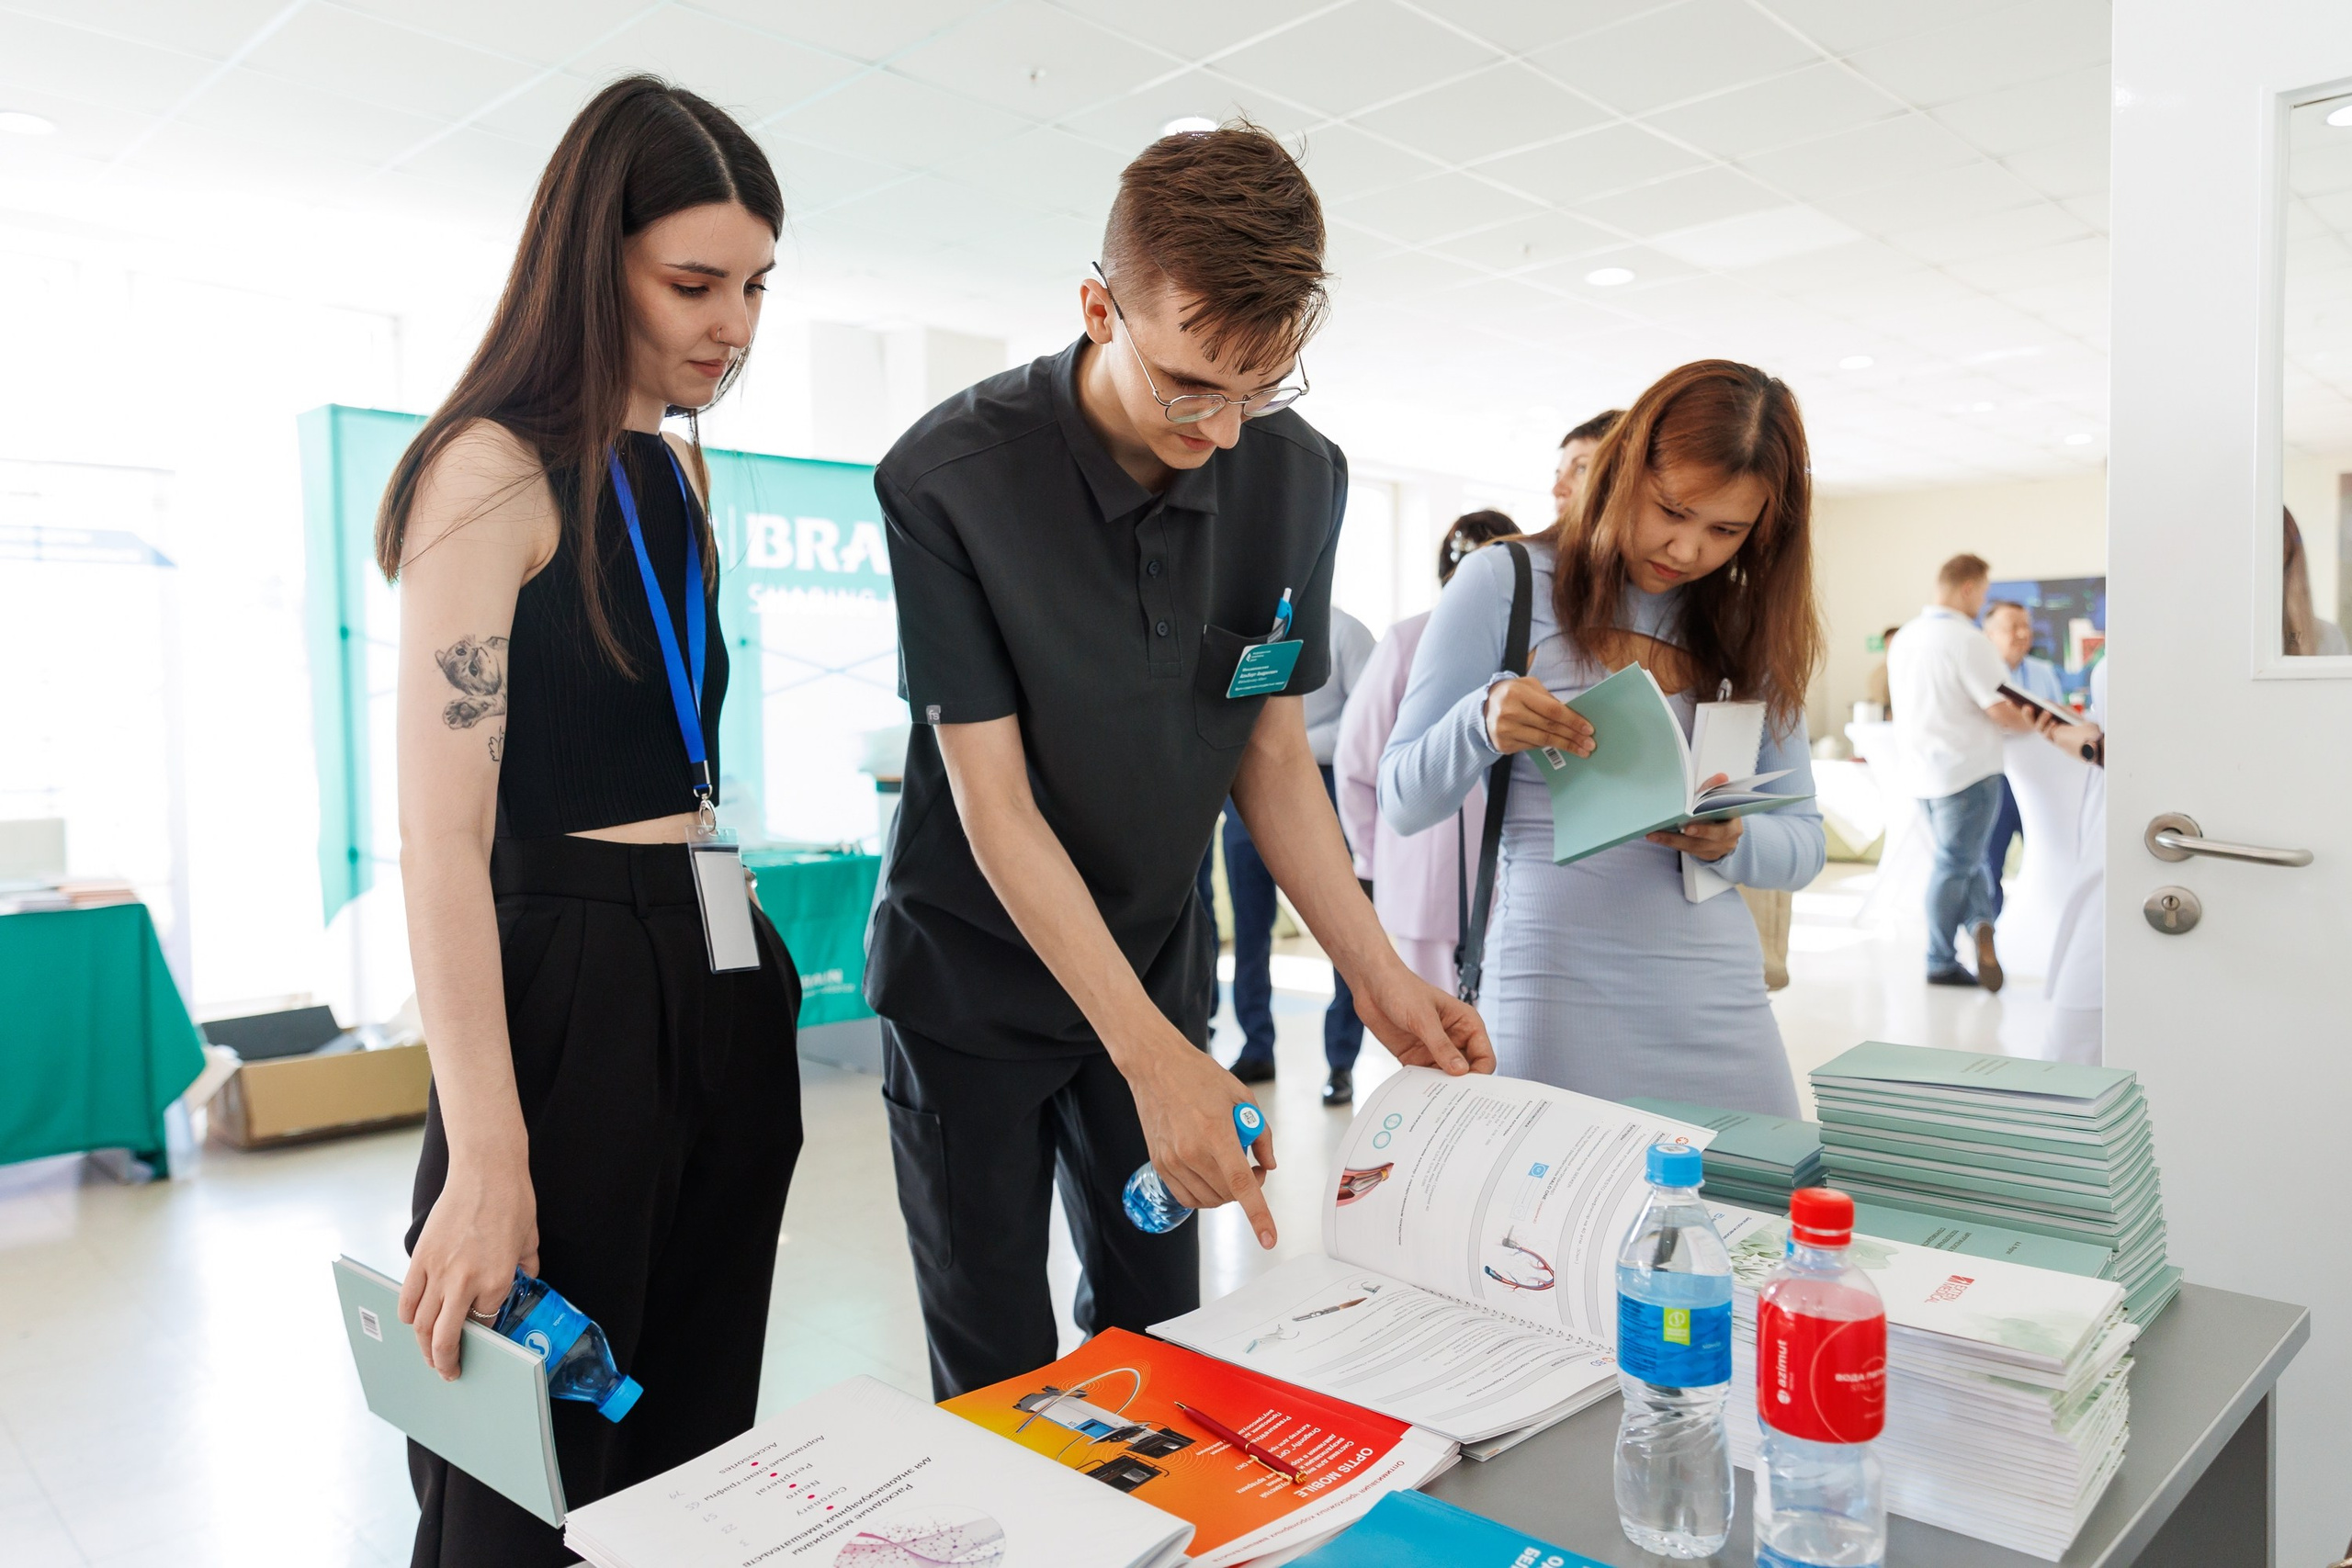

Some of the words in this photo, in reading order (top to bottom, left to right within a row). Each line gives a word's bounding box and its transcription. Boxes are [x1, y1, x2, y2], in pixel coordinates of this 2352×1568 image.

[745, 512, 890, 575] BRA
[1540, 1189, 1550, 1201] ONE
[1545, 1176, 1557, 1190] HALO
[1776, 1339, 1788, 1388] azimut
[1250, 1410, 1283, 1434] Проводник
[1286, 1421, 1312, 1441] Катетер
[715, 1440, 782, 1475] Accessories
[765, 1434, 829, 1469] Аортальные
[1302, 1435, 1346, 1468] визуализации
[1306, 1432, 1338, 1457] давления
[1326, 1438, 1355, 1461] Система
[1335, 1443, 1374, 1476] OPTIS
[752, 1461, 816, 1496] Peripheral
[911, 1456, 934, 1470] для
[1357, 1459, 1406, 1495] Оптимизация
[700, 1464, 772, 1502] стент-графты
[783, 1478, 822, 1501] Neuro
[820, 1467, 917, 1526] эндоваскулярных
[1292, 1468, 1340, 1501] MOBILE
[791, 1484, 850, 1517] Coronary
[852, 1482, 915, 1521] Расходные
[740, 1522, 826, 1568] вмешательств
[788, 1517, 856, 1556] материалы
